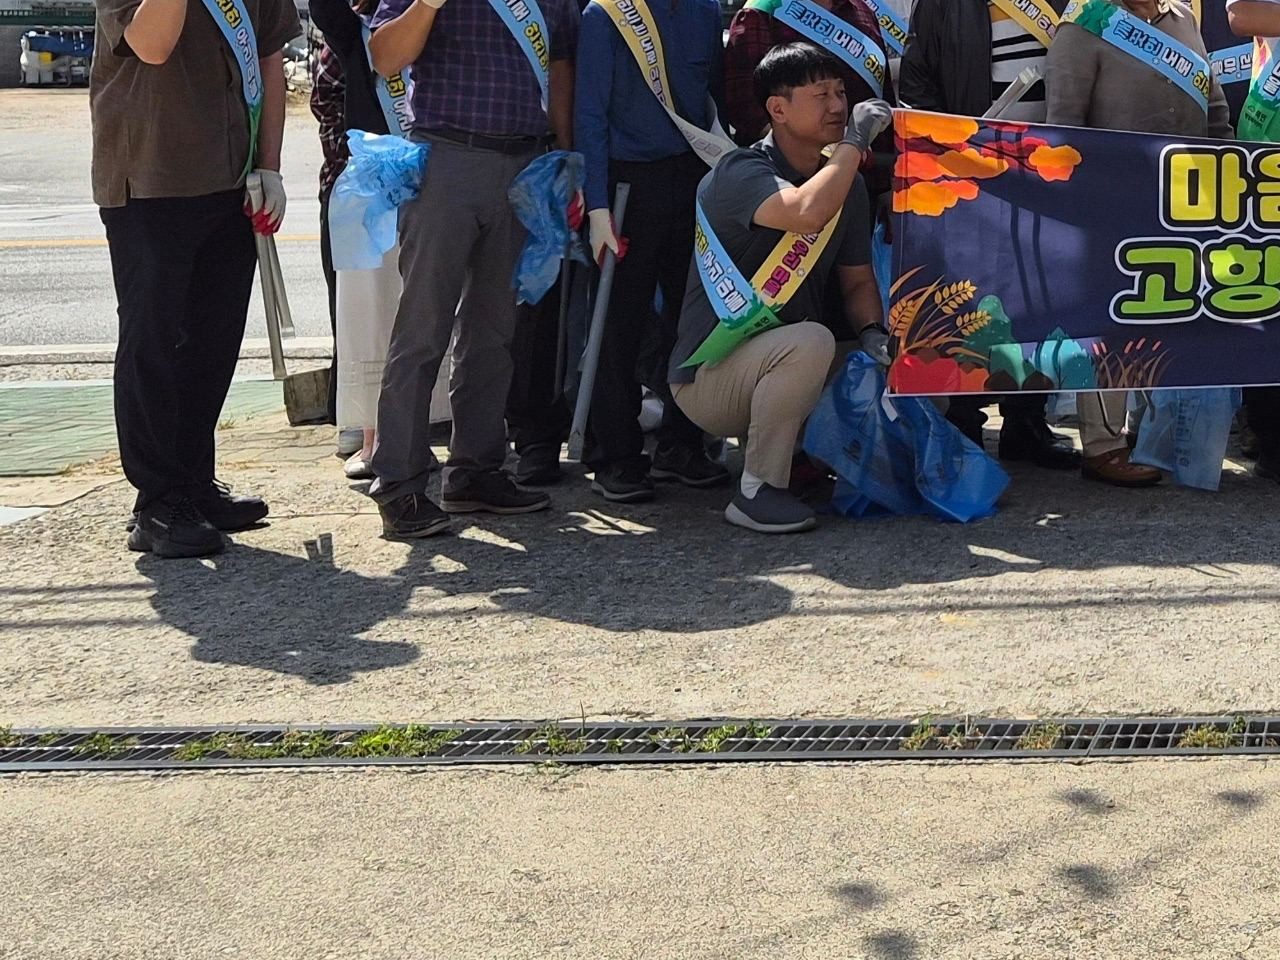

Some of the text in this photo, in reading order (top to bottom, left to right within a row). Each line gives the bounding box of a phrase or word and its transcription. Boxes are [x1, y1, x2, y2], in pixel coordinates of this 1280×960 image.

[785, 0, 835, 37] 깨끗한
[832, 28, 866, 59] 도로
[1112, 17, 1194, 79] 깨끗한 도로
[703, 250, 725, 284] 우리
[716, 276, 748, 314] 마을
